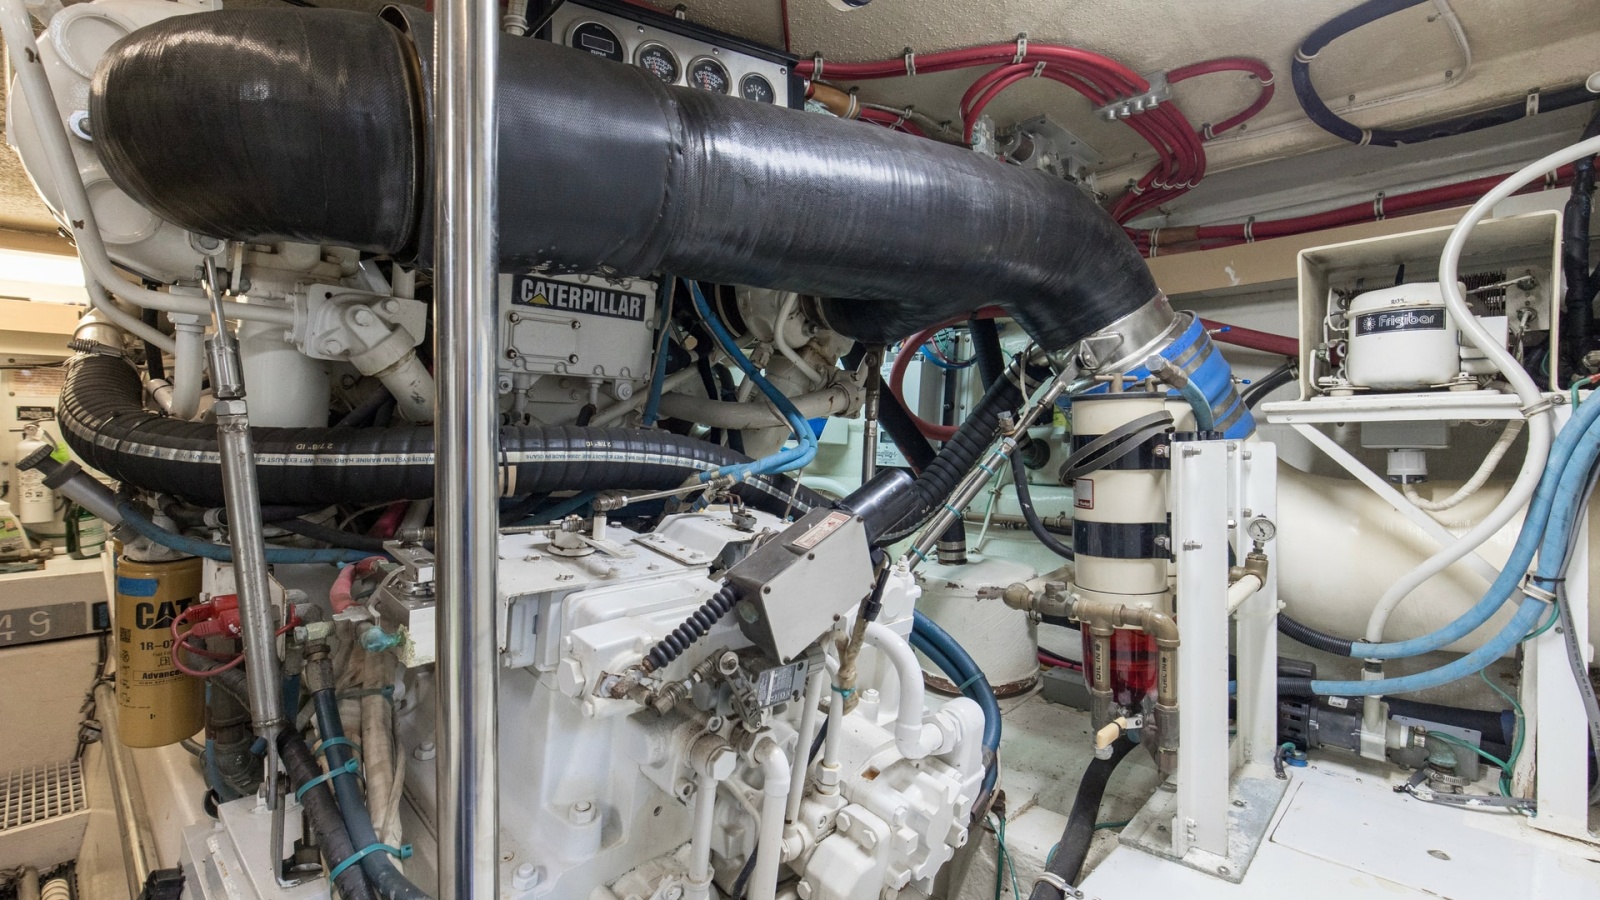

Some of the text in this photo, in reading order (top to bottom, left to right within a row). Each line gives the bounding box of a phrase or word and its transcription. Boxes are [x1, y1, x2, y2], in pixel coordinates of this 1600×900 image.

[520, 278, 641, 318] CATERPILLAR
[1378, 312, 1435, 328] Frigibar
[136, 598, 194, 630] CAT
[140, 639, 175, 650] 1R-07
[1096, 653, 1100, 662] IN
[1162, 664, 1167, 672] IN
